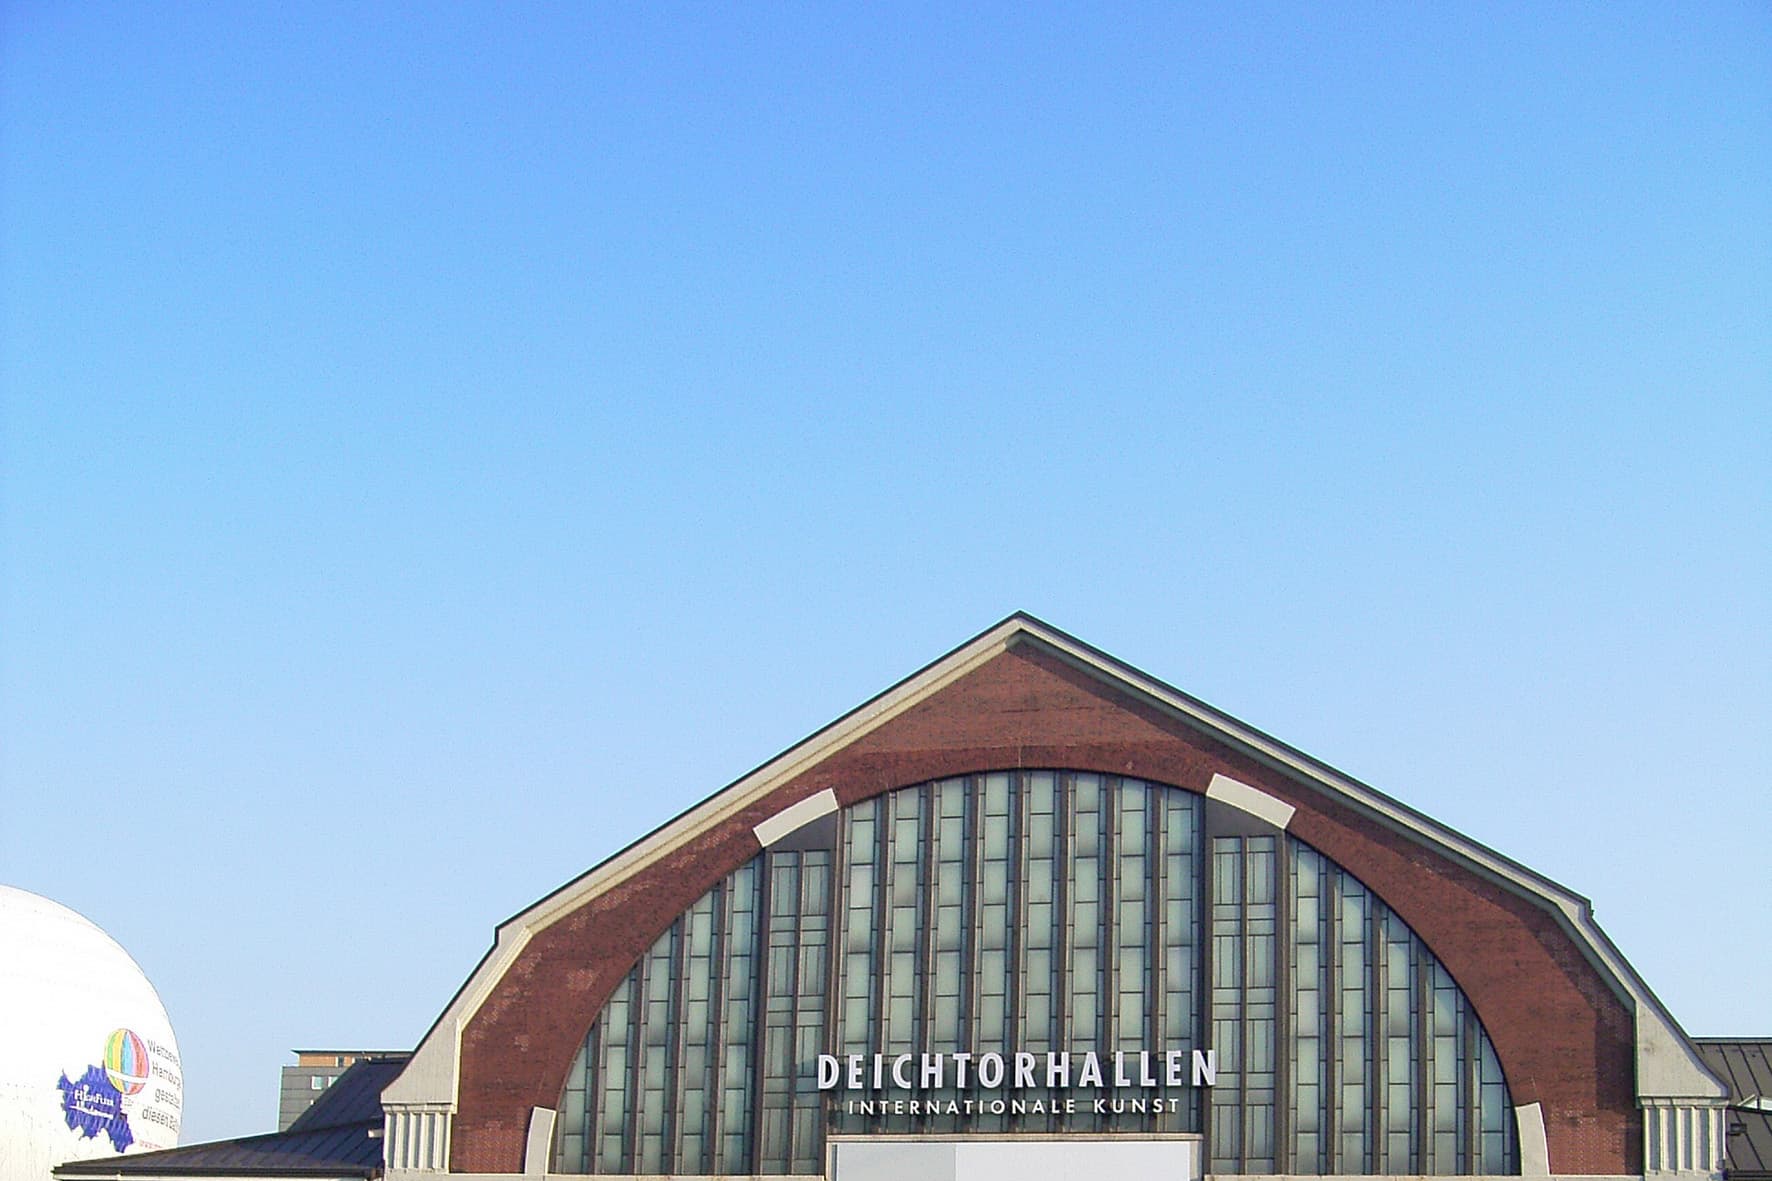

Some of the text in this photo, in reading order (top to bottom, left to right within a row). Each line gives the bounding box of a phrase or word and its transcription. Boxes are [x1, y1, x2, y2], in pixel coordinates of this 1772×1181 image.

[817, 1050, 1217, 1089] DEICHTORHALLEN
[848, 1097, 1180, 1116] INTERNATIONALE KUNST
